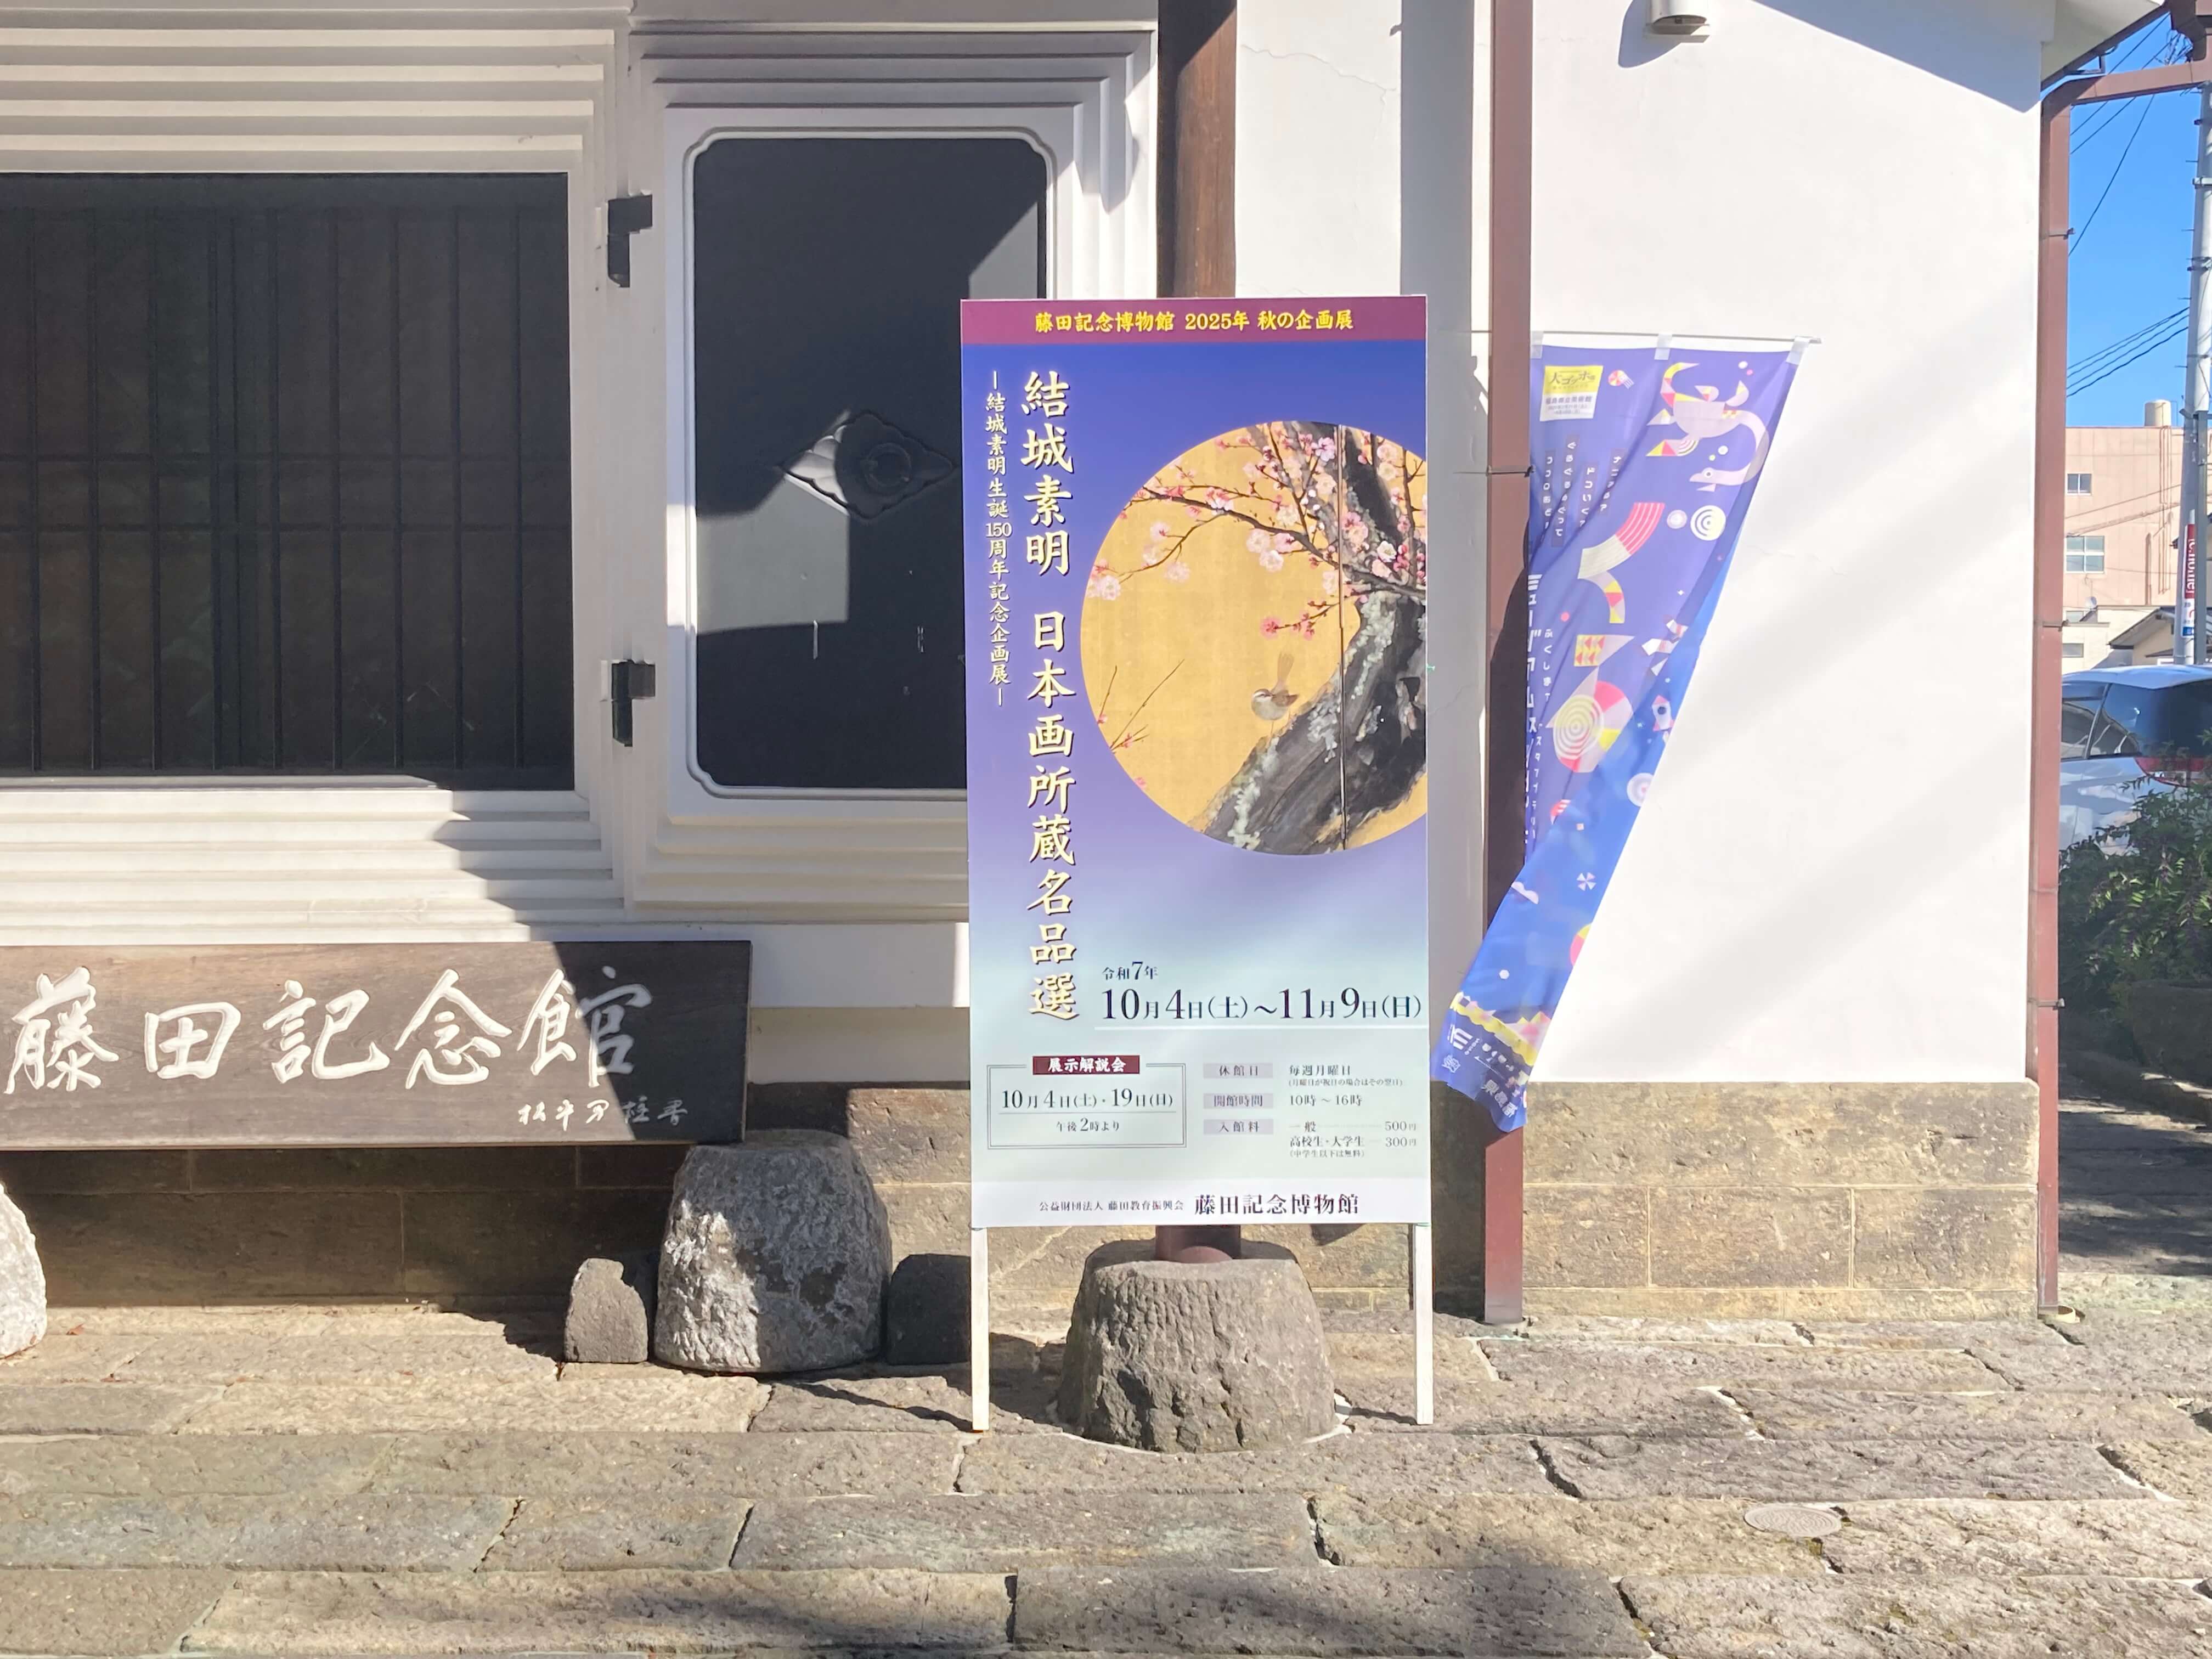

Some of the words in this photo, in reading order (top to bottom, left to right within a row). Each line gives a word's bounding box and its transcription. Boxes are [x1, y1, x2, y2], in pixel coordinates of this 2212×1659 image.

[1035, 312, 1175, 332] 藤田記念博物館
[1185, 312, 1250, 331] 2025年
[1257, 309, 1354, 330] 秋の企画展
[1021, 371, 1074, 576] 結城素明
[1027, 611, 1080, 1020] 日本画所蔵名品選
[1102, 961, 1158, 981] 令和7年
[3, 967, 653, 1095] 藤田記念館
[1048, 1057, 1126, 1073] 展示解説会
[1219, 1065, 1259, 1076] 休館日
[1289, 1064, 1351, 1076] 毎週月曜日
[1213, 1094, 1263, 1107] 開館時間
[1057, 1117, 1120, 1132] 午後2時より
[1218, 1121, 1260, 1132] 入館料
[1288, 1121, 1316, 1132] 一般
[1385, 1121, 1417, 1131] 500円
[1289, 1136, 1364, 1148] 高校生・大学生
[1385, 1137, 1417, 1148] 300円
[1289, 1149, 1365, 1159] (中学生以下は無料)
[1040, 1200, 1104, 1212] 公益財団法人
[1108, 1199, 1184, 1211] 藤田教育振興会
[1194, 1193, 1359, 1215] 藤田記念博物館
